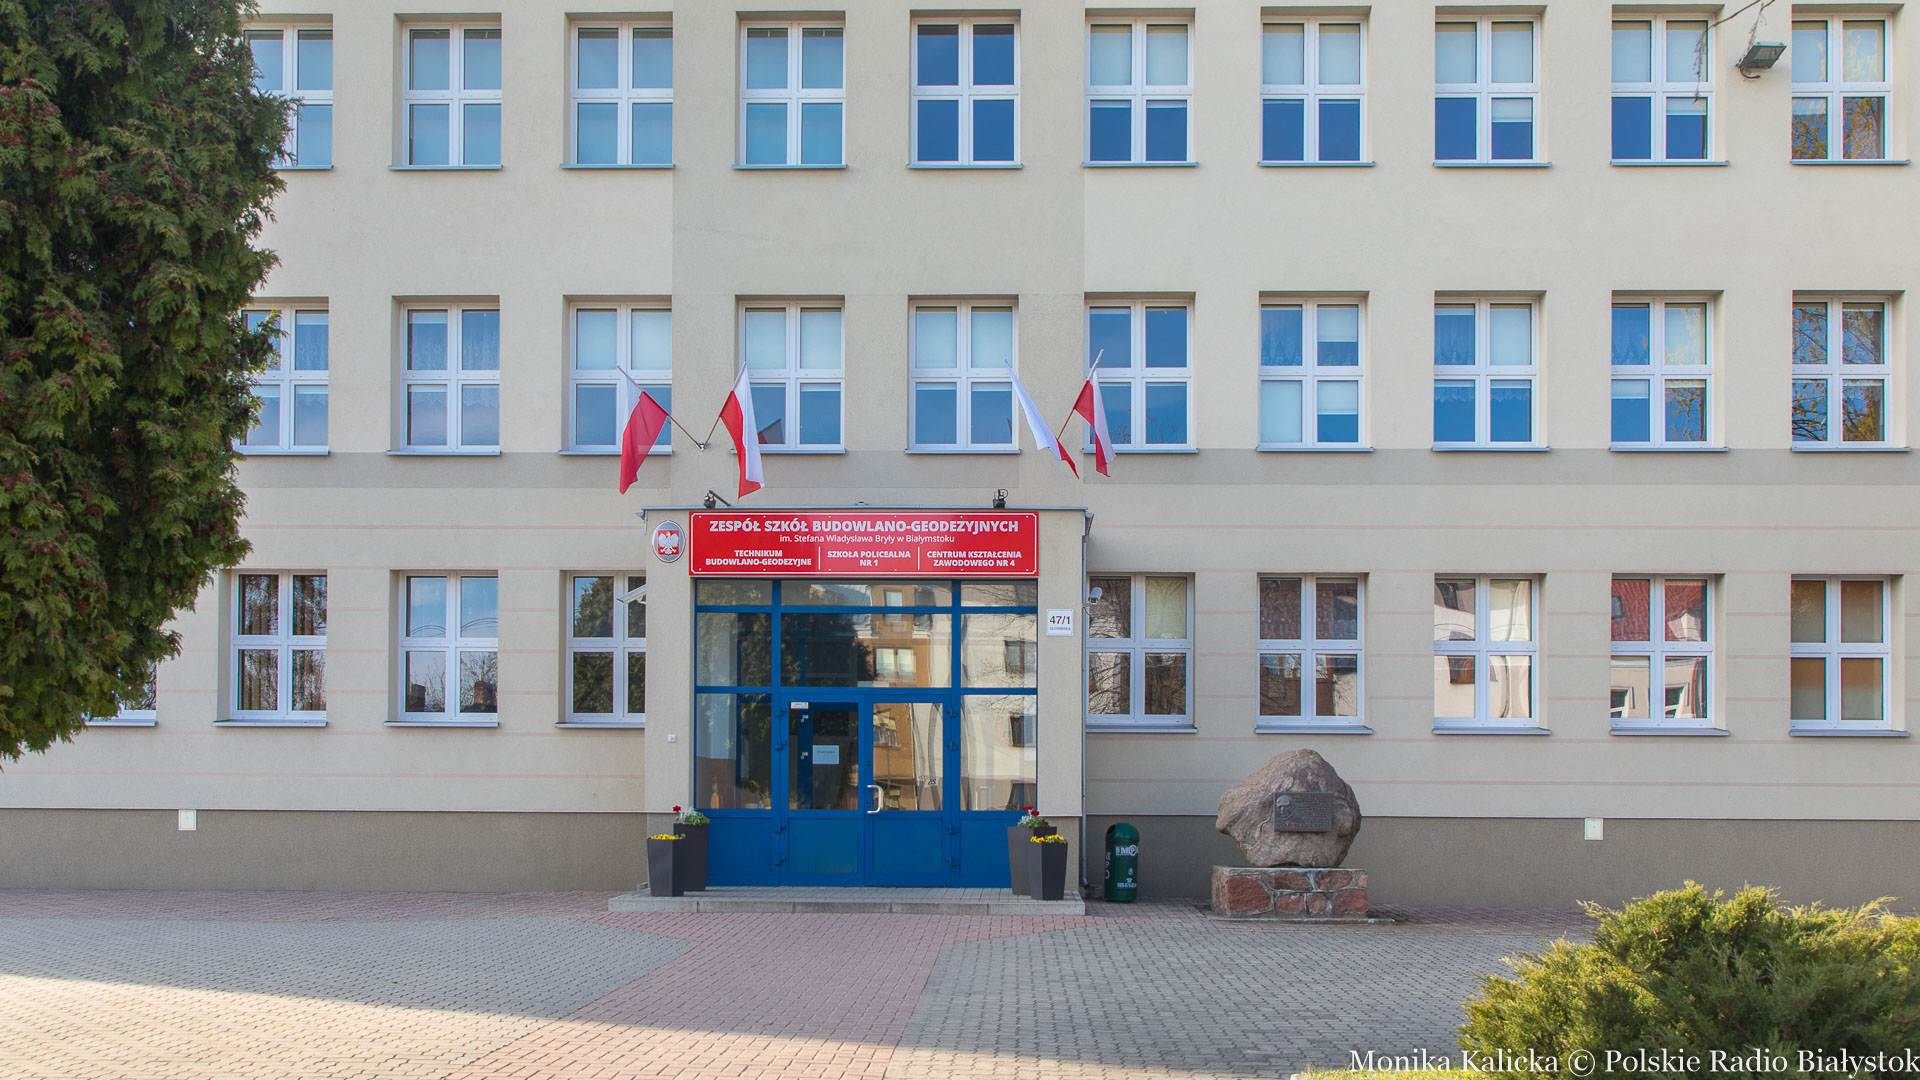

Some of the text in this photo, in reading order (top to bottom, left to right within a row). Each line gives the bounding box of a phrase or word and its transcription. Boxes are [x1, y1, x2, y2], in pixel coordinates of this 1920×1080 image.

[709, 517, 1019, 535] ZESPÓŁ SZKÓŁ BUDOWLANO-GEODEZYJNYCH
[779, 534, 793, 543] im.
[794, 534, 824, 543] Stefana
[826, 534, 873, 545] Władysława
[875, 534, 895, 545] Bryły
[906, 534, 955, 545] Białymstoku
[734, 549, 783, 558] TECHNIKUM
[827, 551, 911, 559] SZKOŁA POLICEALNA
[926, 551, 1022, 559] CENTRUM KSZTAŁCENIA
[705, 558, 812, 567] BUDOWLANO-GEODEZYJNE
[859, 559, 879, 567] NR 1
[933, 559, 1016, 567] ZAWODOWEGO NR 4
[1049, 615, 1070, 625] 47/1
